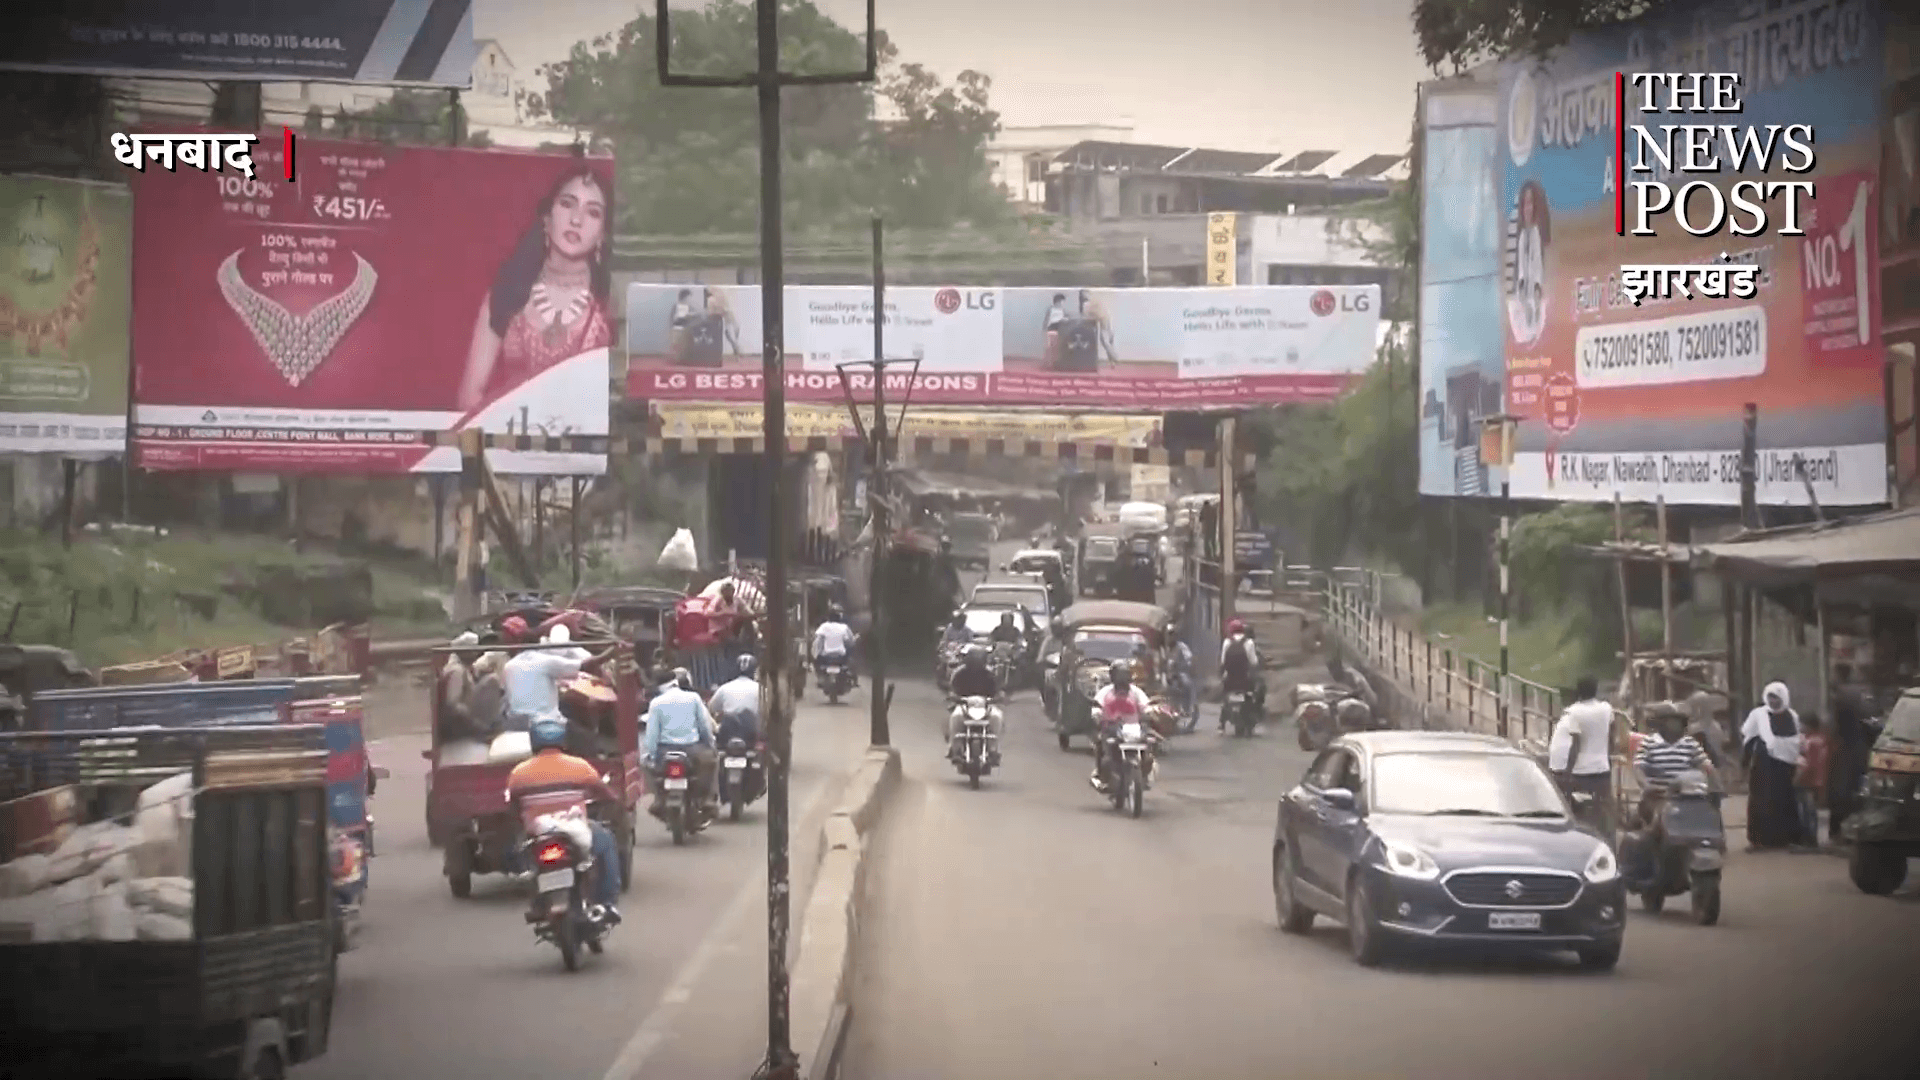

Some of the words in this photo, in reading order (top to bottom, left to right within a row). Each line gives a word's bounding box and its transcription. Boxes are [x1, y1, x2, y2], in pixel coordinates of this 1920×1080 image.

[261, 234, 297, 249] 100%
[1804, 235, 1841, 290] NO.
[966, 291, 995, 311] LG
[1341, 294, 1370, 312] LG
[1678, 320, 1761, 361] 7520091581
[654, 373, 687, 389] LG
[695, 373, 764, 389] BEST
[783, 373, 842, 389] HOP
[1662, 454, 1710, 483] Dhanbad
[1720, 453, 1760, 483] 8280
[1764, 450, 1839, 488] (Jharand)
